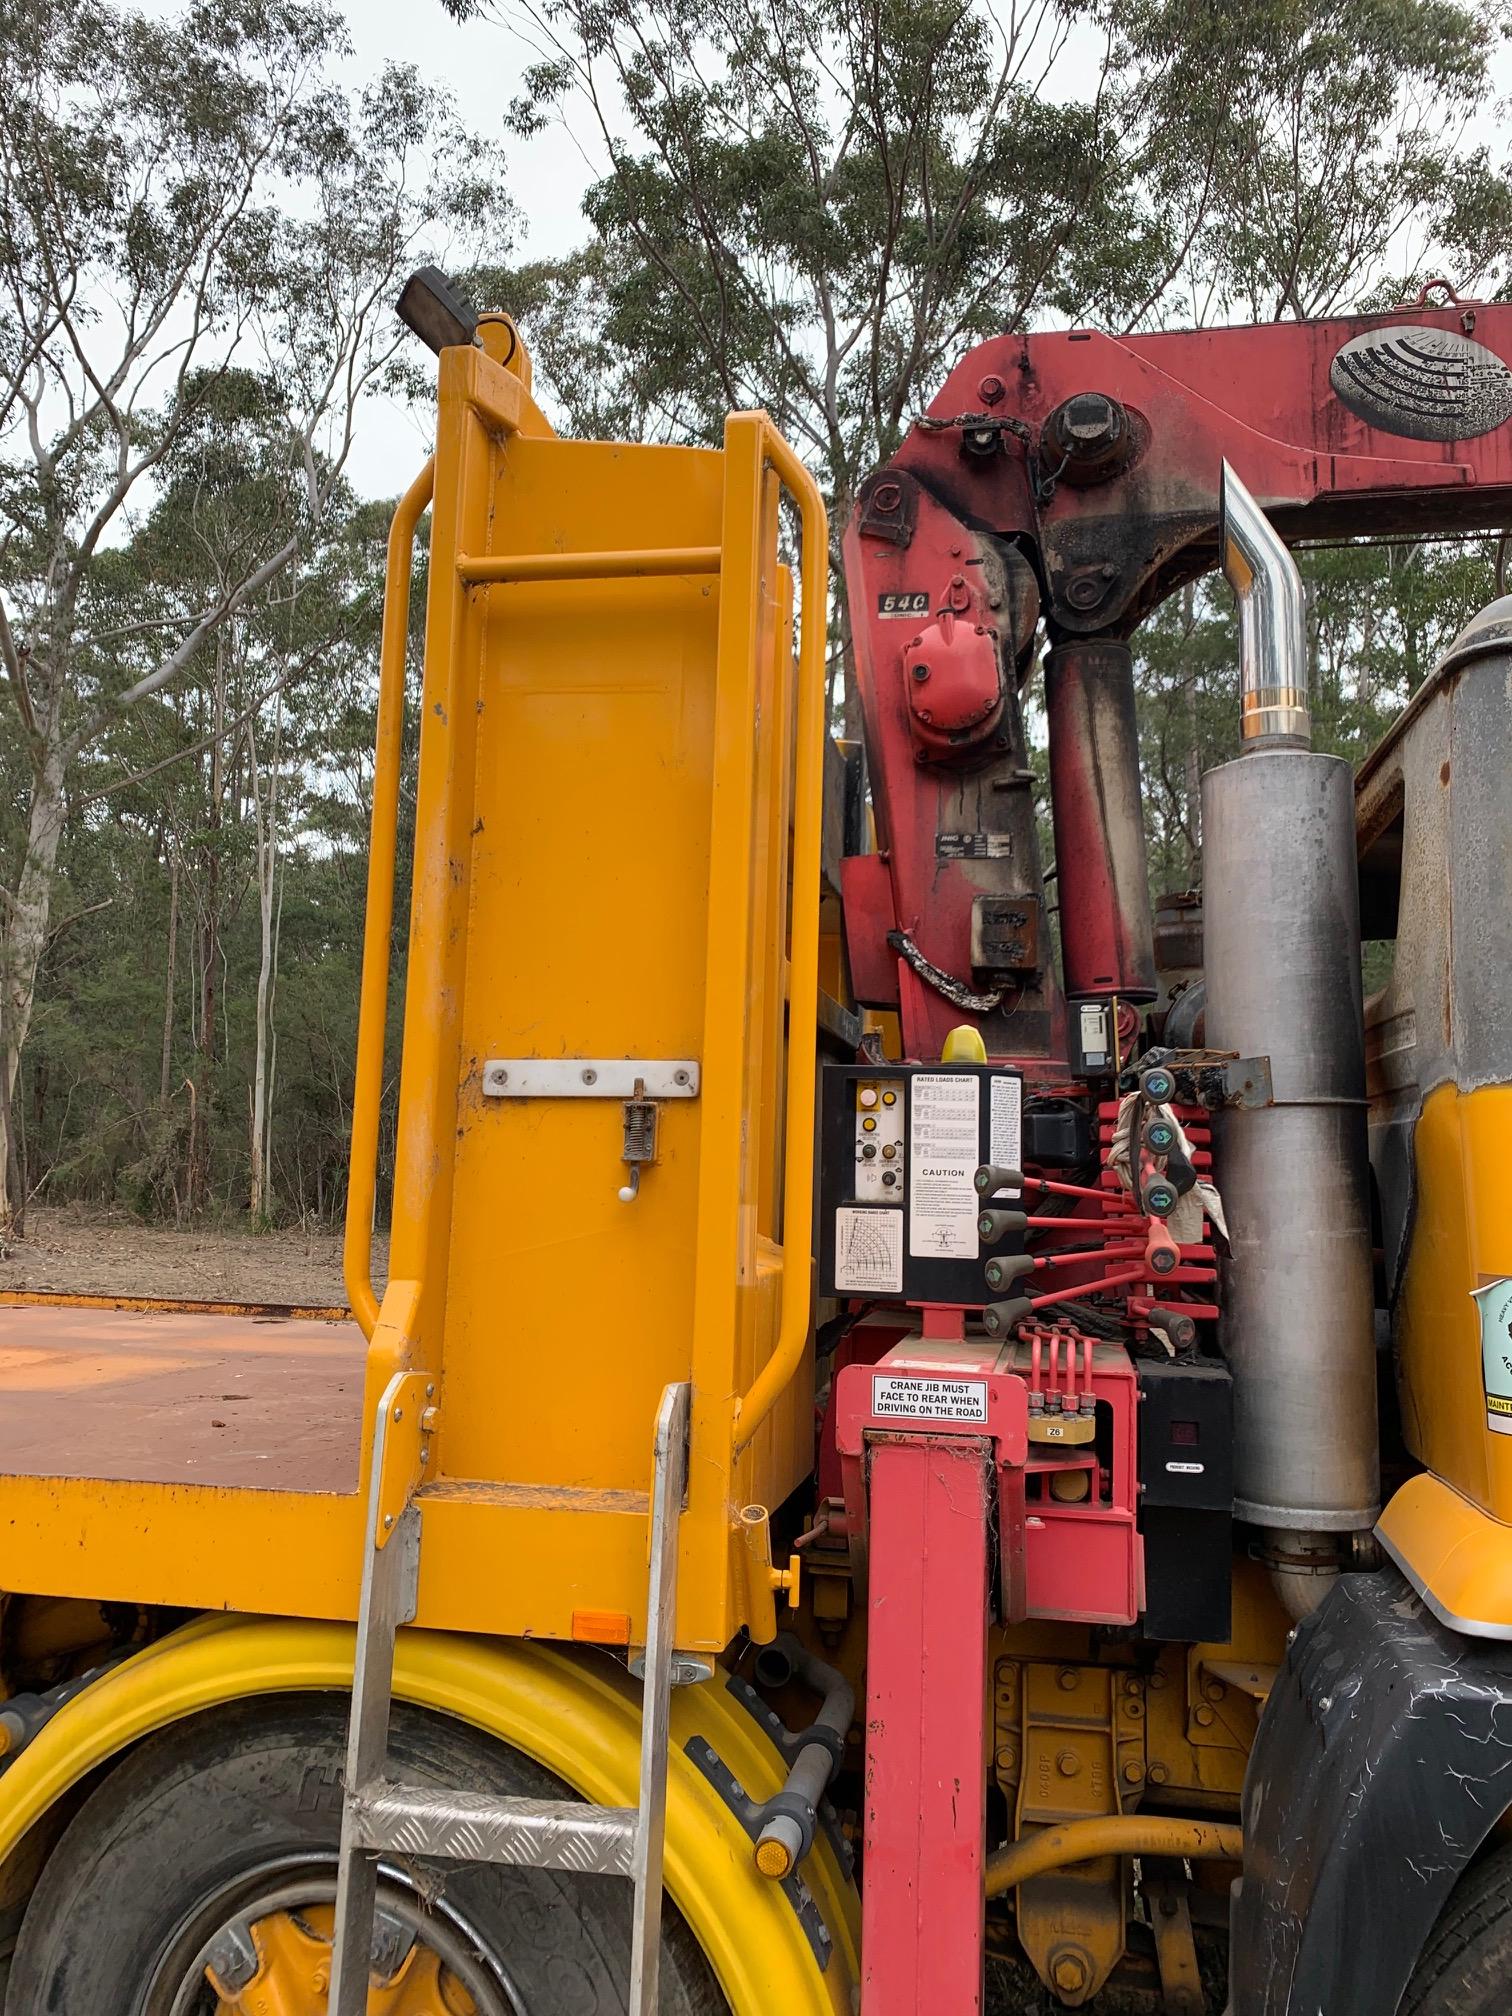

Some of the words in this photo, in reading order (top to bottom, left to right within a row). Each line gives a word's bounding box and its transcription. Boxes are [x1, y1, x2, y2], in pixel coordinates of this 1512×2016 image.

[883, 594, 925, 611] 540
[922, 1168, 965, 1177] CAUTION
[890, 1381, 923, 1391] CRANE
[925, 1383, 940, 1392] JIB
[942, 1384, 970, 1394] MUST
[880, 1391, 905, 1401] FACE
[907, 1393, 919, 1402] TO
[921, 1394, 948, 1404] REAR
[950, 1396, 980, 1406] WHEN
[877, 1402, 916, 1413] DRIVING
[919, 1405, 932, 1414] ON
[935, 1406, 954, 1415] THE
[956, 1408, 983, 1417] ROAD
